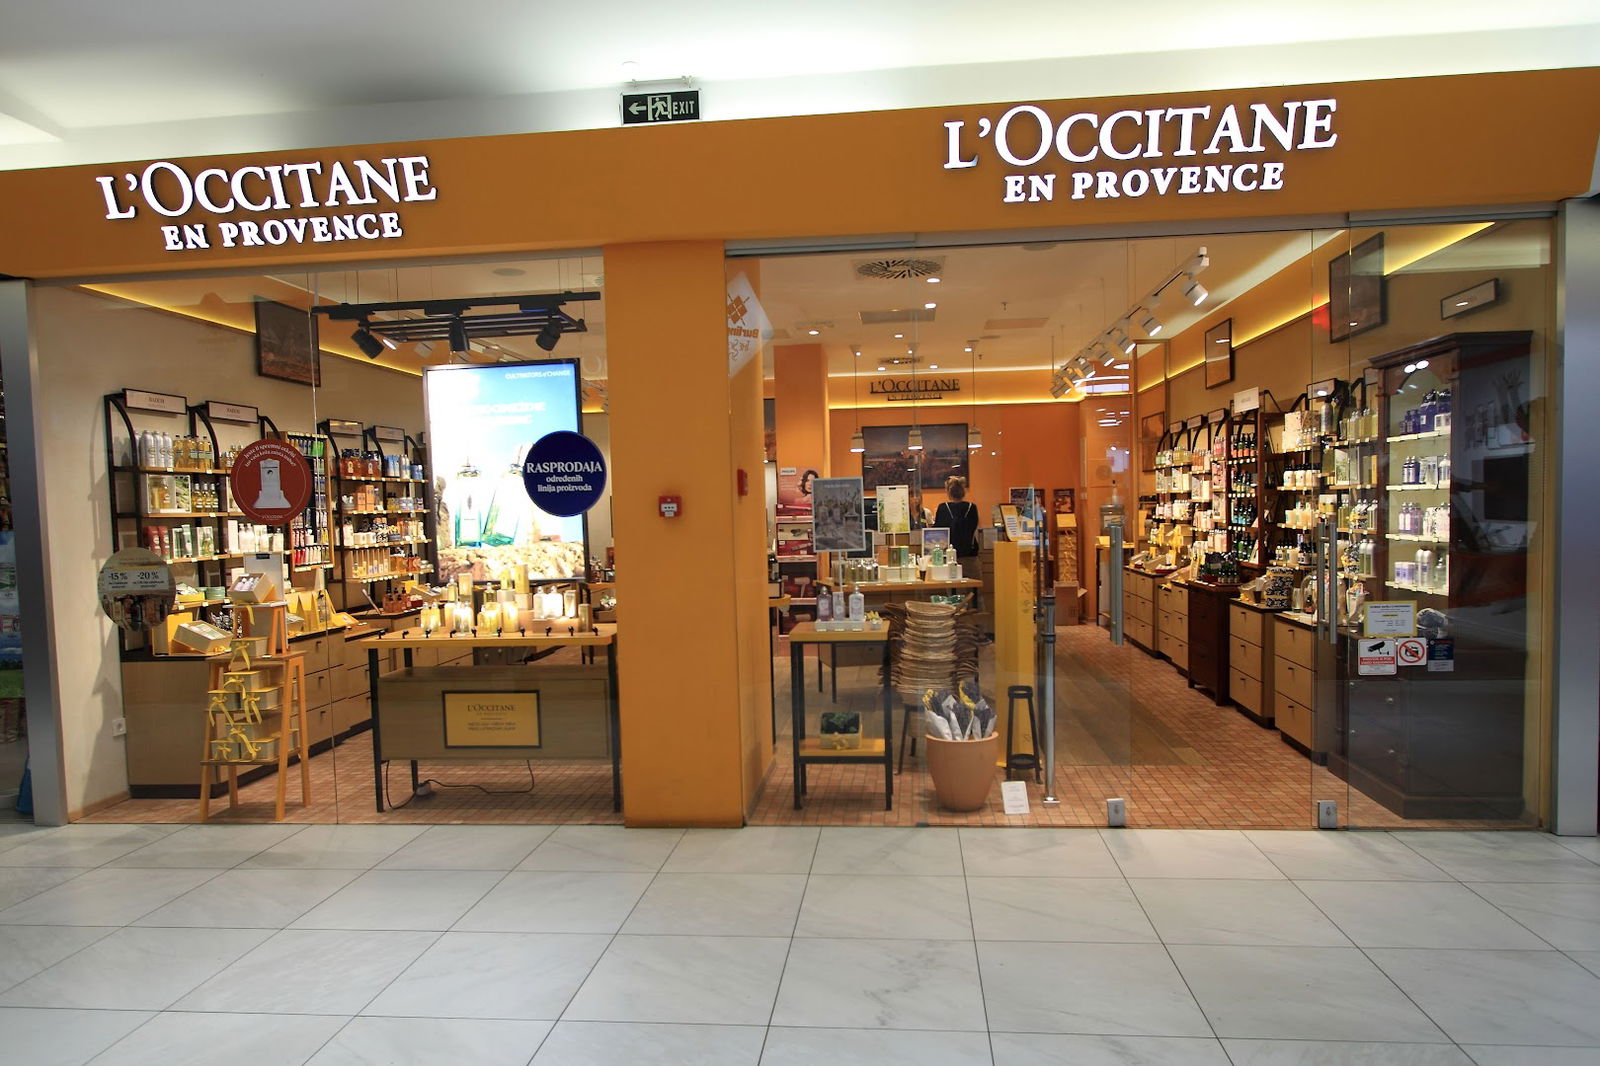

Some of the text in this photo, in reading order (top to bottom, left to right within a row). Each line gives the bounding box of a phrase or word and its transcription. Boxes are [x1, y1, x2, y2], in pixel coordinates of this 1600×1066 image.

[672, 100, 694, 115] EXIT
[943, 98, 1338, 170] L'OCCITANE
[95, 154, 438, 220] L'OCCITANE
[1003, 162, 1285, 203] EN PROVENCE
[161, 212, 402, 251] EN PROVENCE
[870, 378, 960, 394] L'OCCITANE
[526, 462, 602, 474] RASPRODAJA
[537, 483, 592, 493] linija proizvoda
